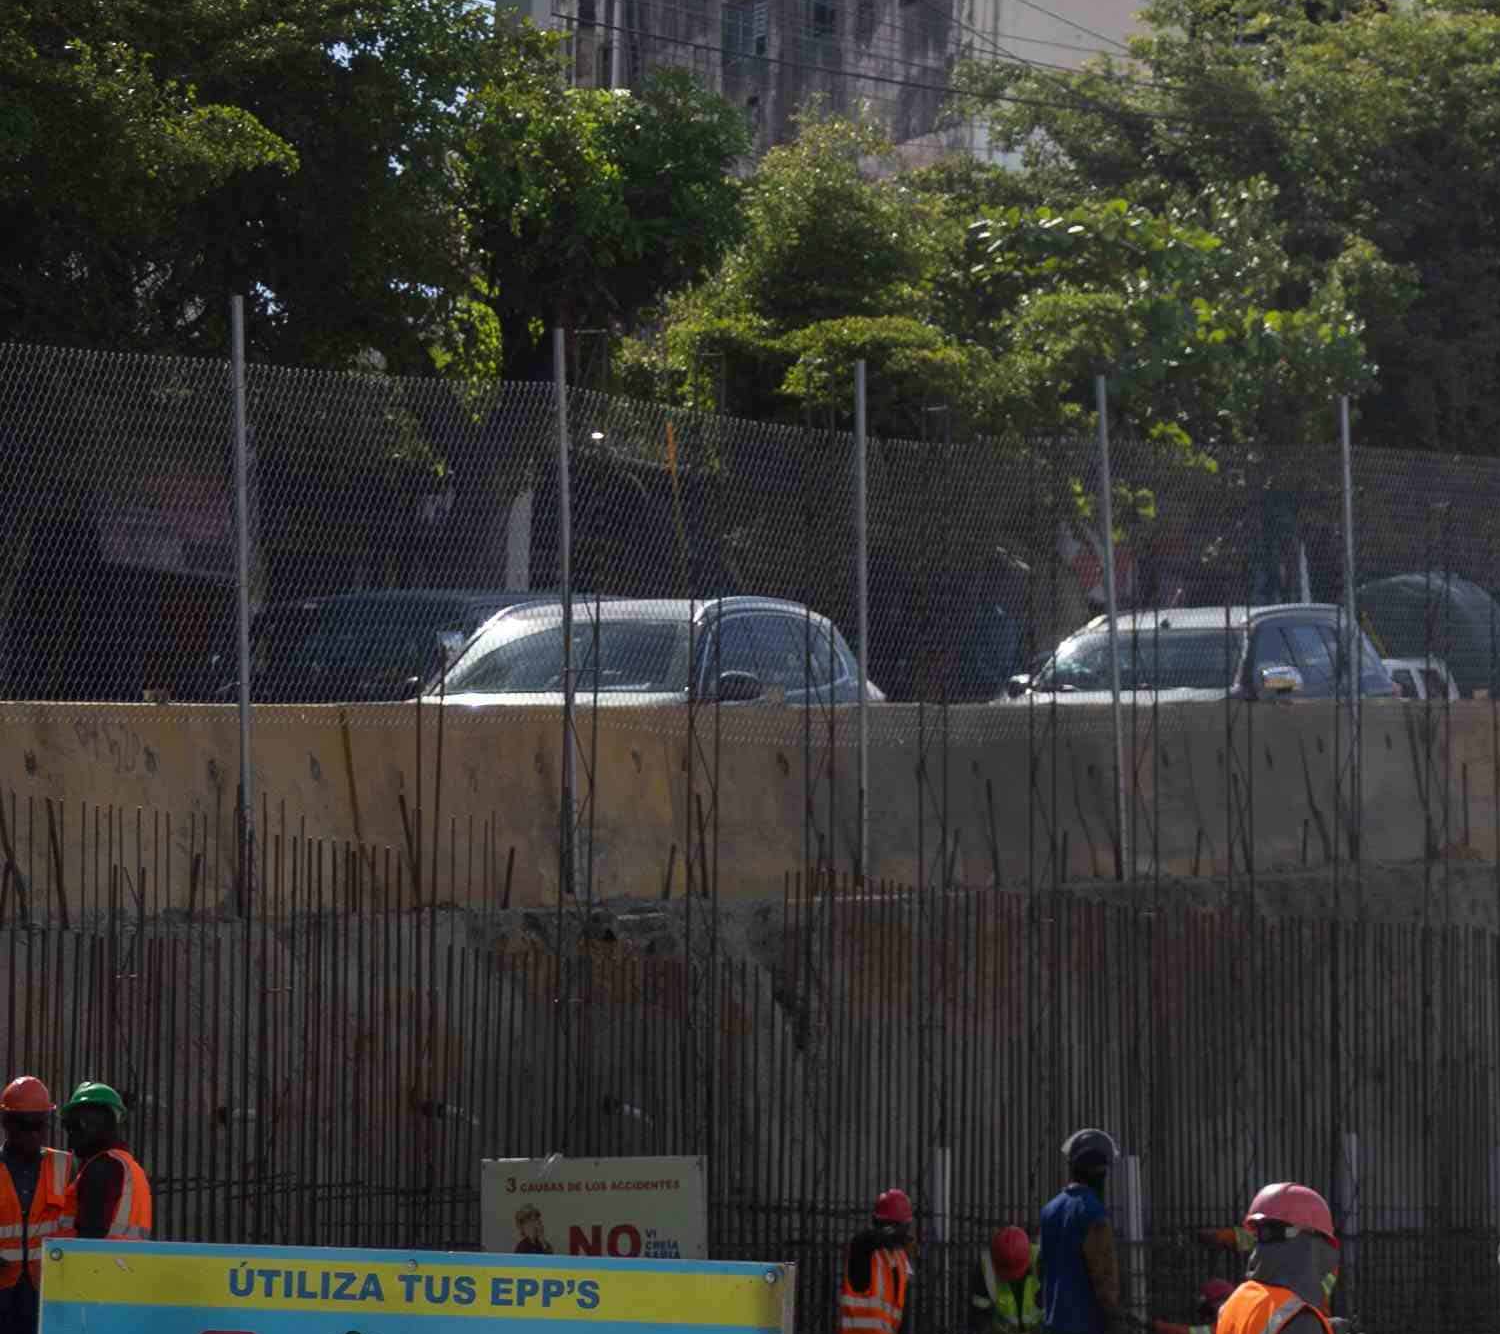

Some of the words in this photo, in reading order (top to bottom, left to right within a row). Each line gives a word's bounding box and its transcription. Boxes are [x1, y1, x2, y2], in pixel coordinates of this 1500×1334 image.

[505, 1178, 517, 1193] 3
[520, 1182, 565, 1193] CAUSAS
[568, 1182, 582, 1192] DE
[585, 1181, 608, 1192] LOS
[611, 1179, 680, 1191] ACCIDENTES
[569, 1224, 642, 1258] NO
[229, 1262, 385, 1302] ÚTILIZA
[398, 1274, 476, 1306] TUS
[490, 1277, 601, 1310] EPP'S
